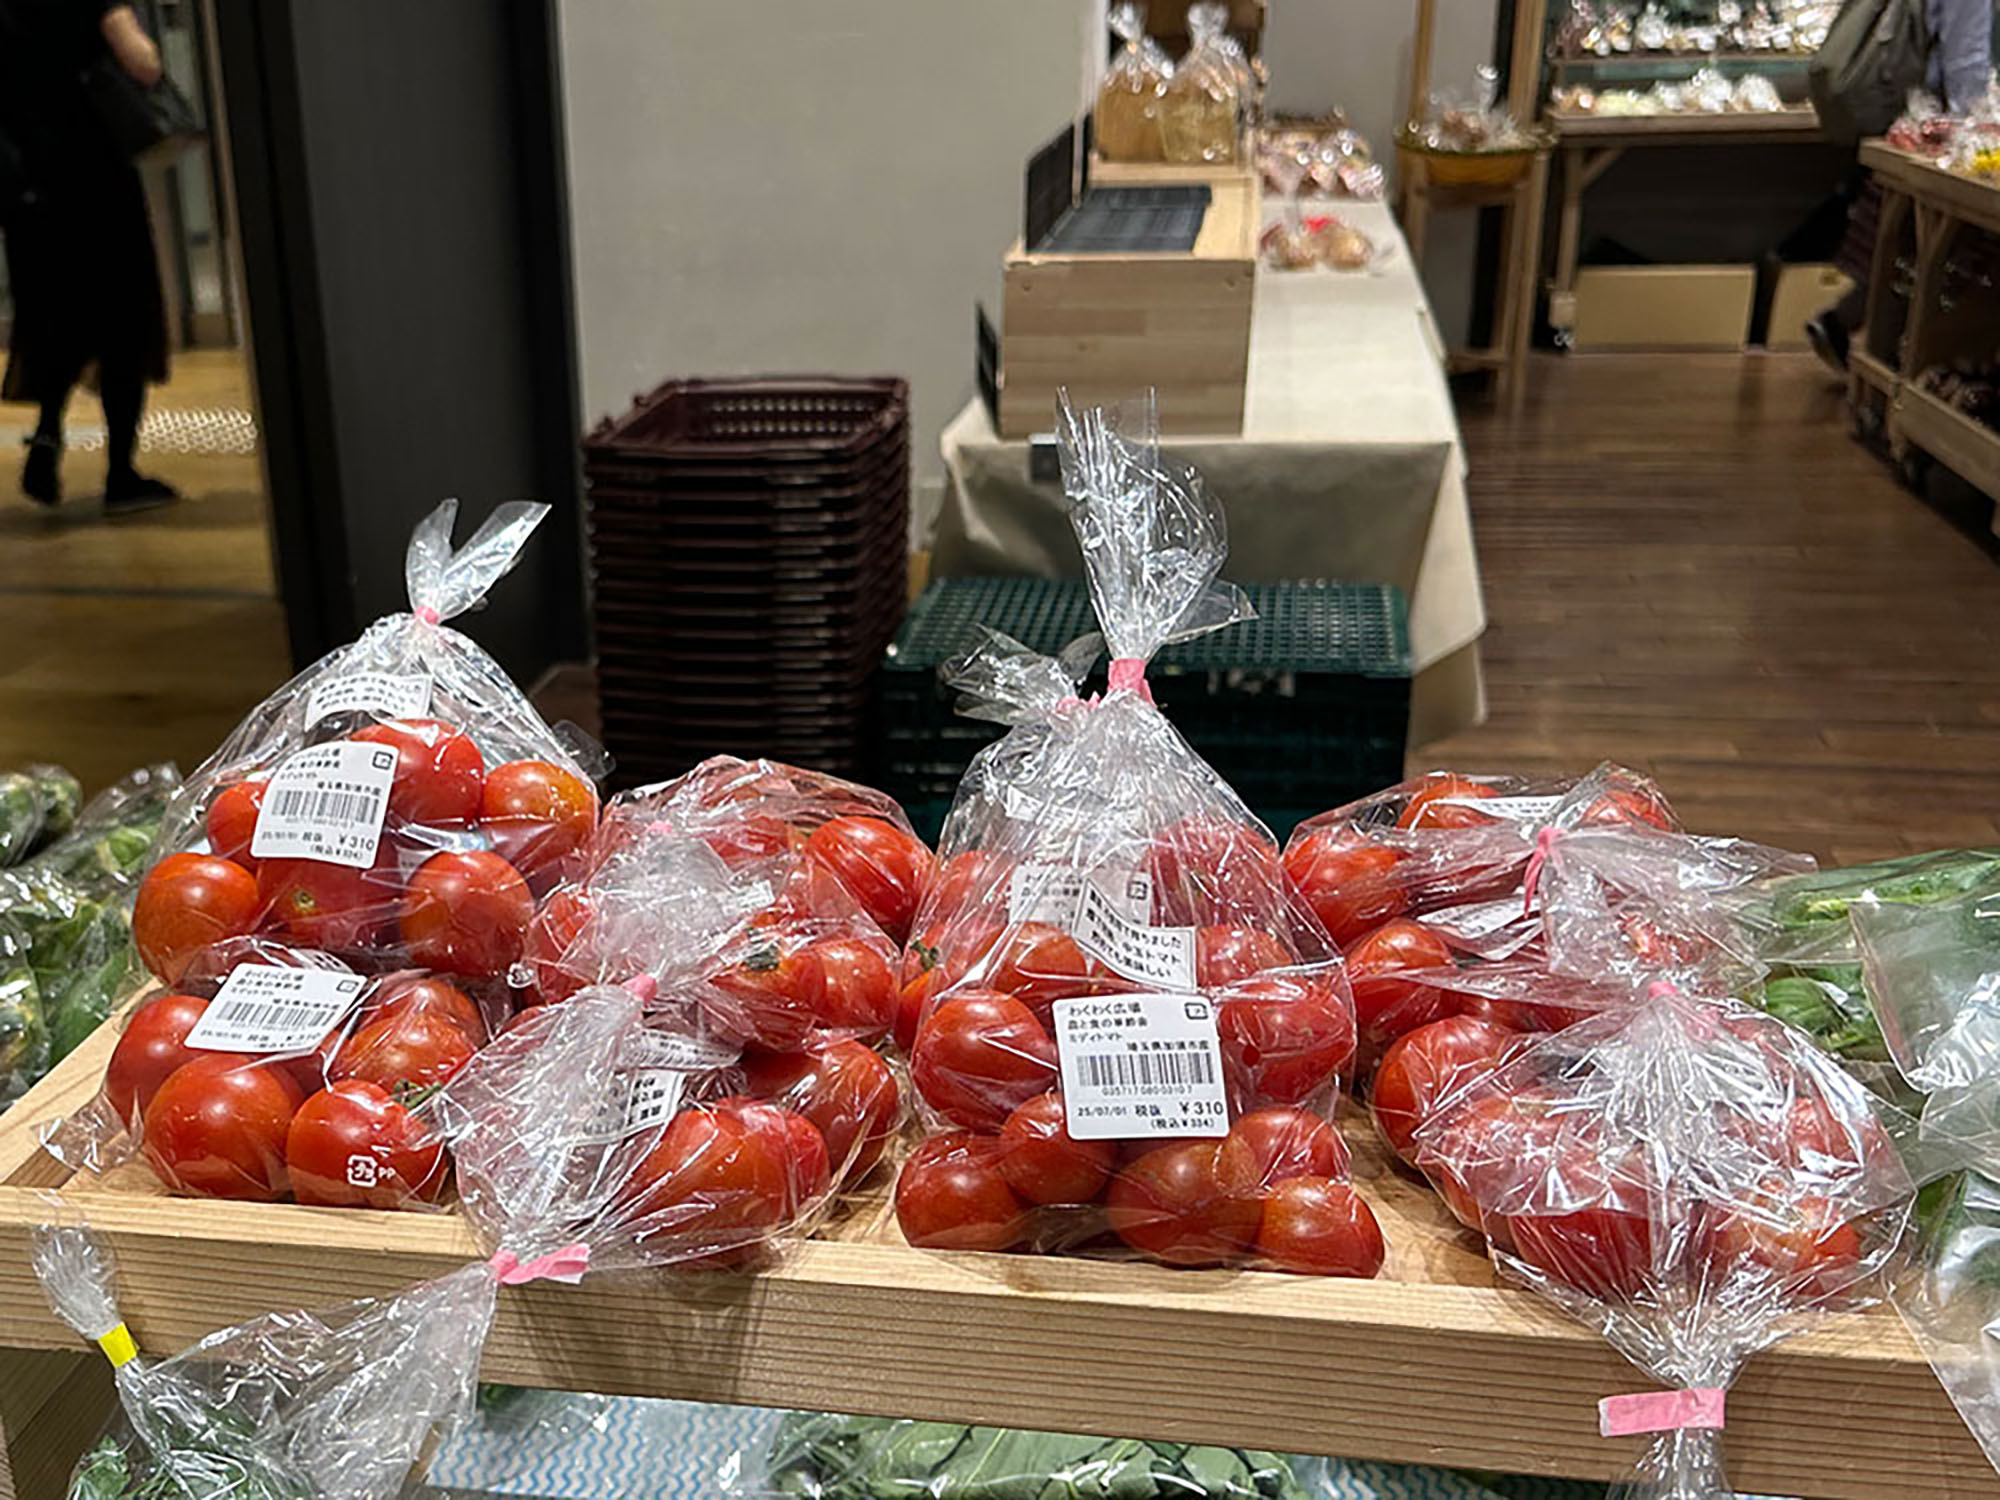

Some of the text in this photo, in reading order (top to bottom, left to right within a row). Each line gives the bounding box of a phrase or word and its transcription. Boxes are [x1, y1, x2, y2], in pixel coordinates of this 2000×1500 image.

[1068, 1002, 1142, 1017] わくわく広場
[1178, 1101, 1224, 1116] ¥310
